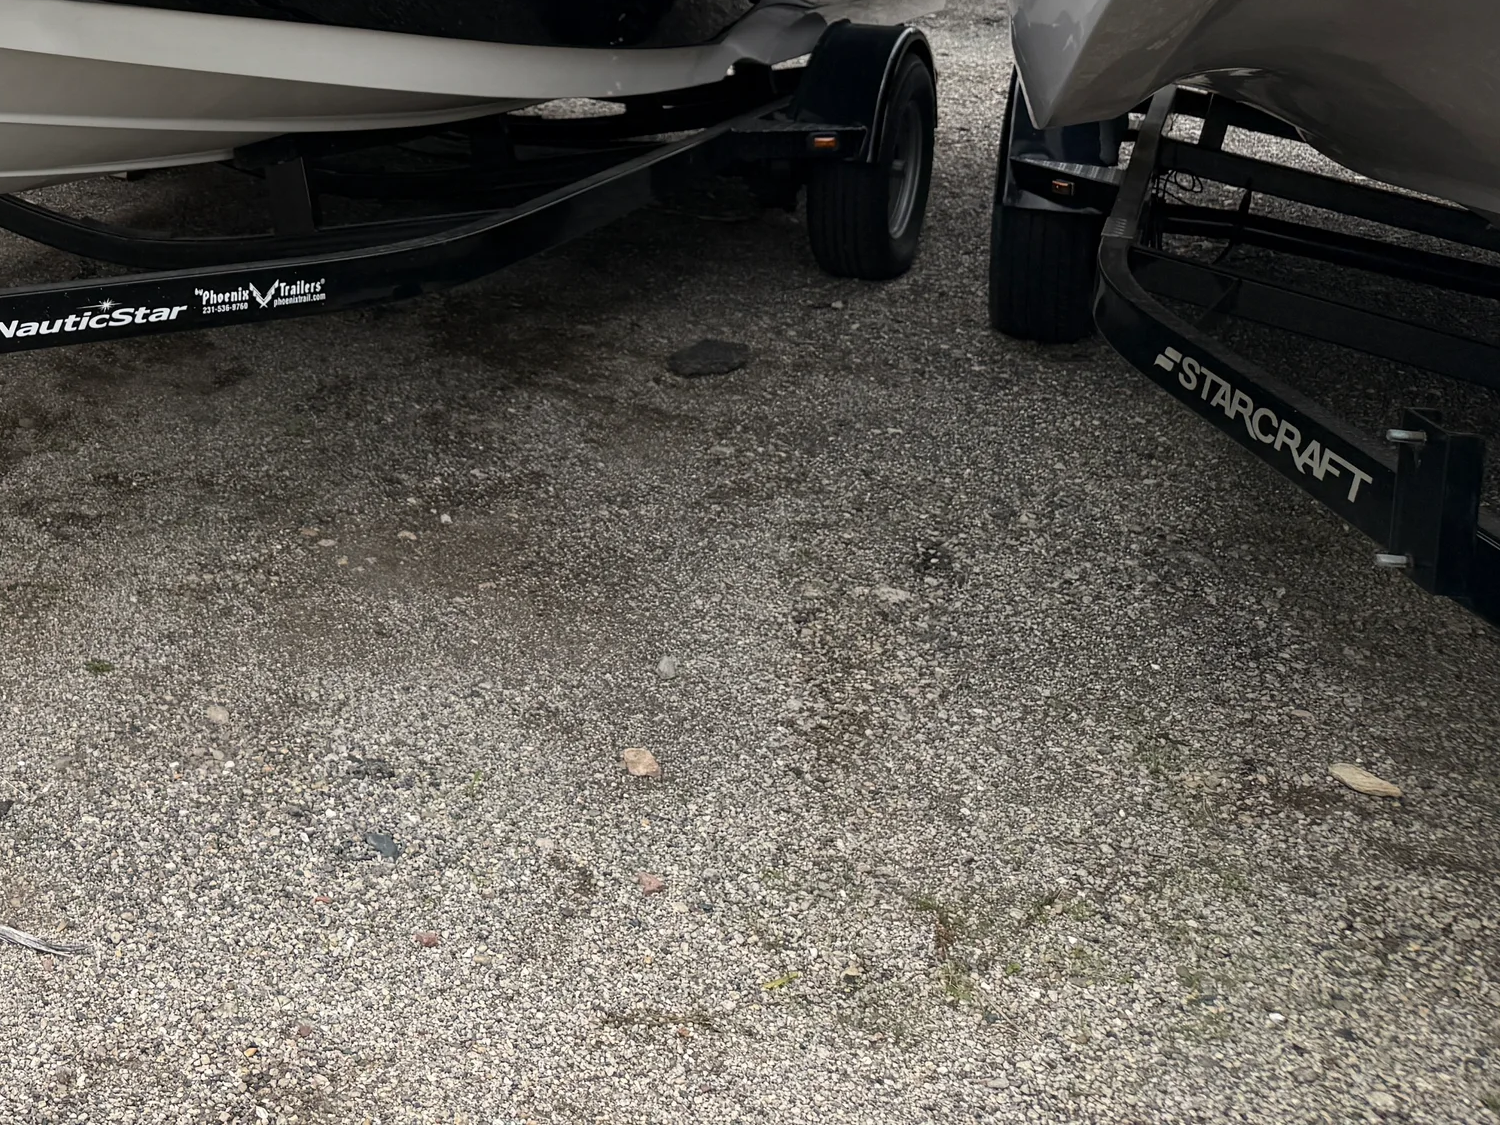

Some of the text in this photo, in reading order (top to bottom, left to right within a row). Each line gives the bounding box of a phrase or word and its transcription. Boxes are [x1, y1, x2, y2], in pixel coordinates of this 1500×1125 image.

[202, 286, 250, 306] Phoenix
[273, 292, 327, 308] phoenixtrail.com
[1178, 356, 1374, 503] STARCRAFT
